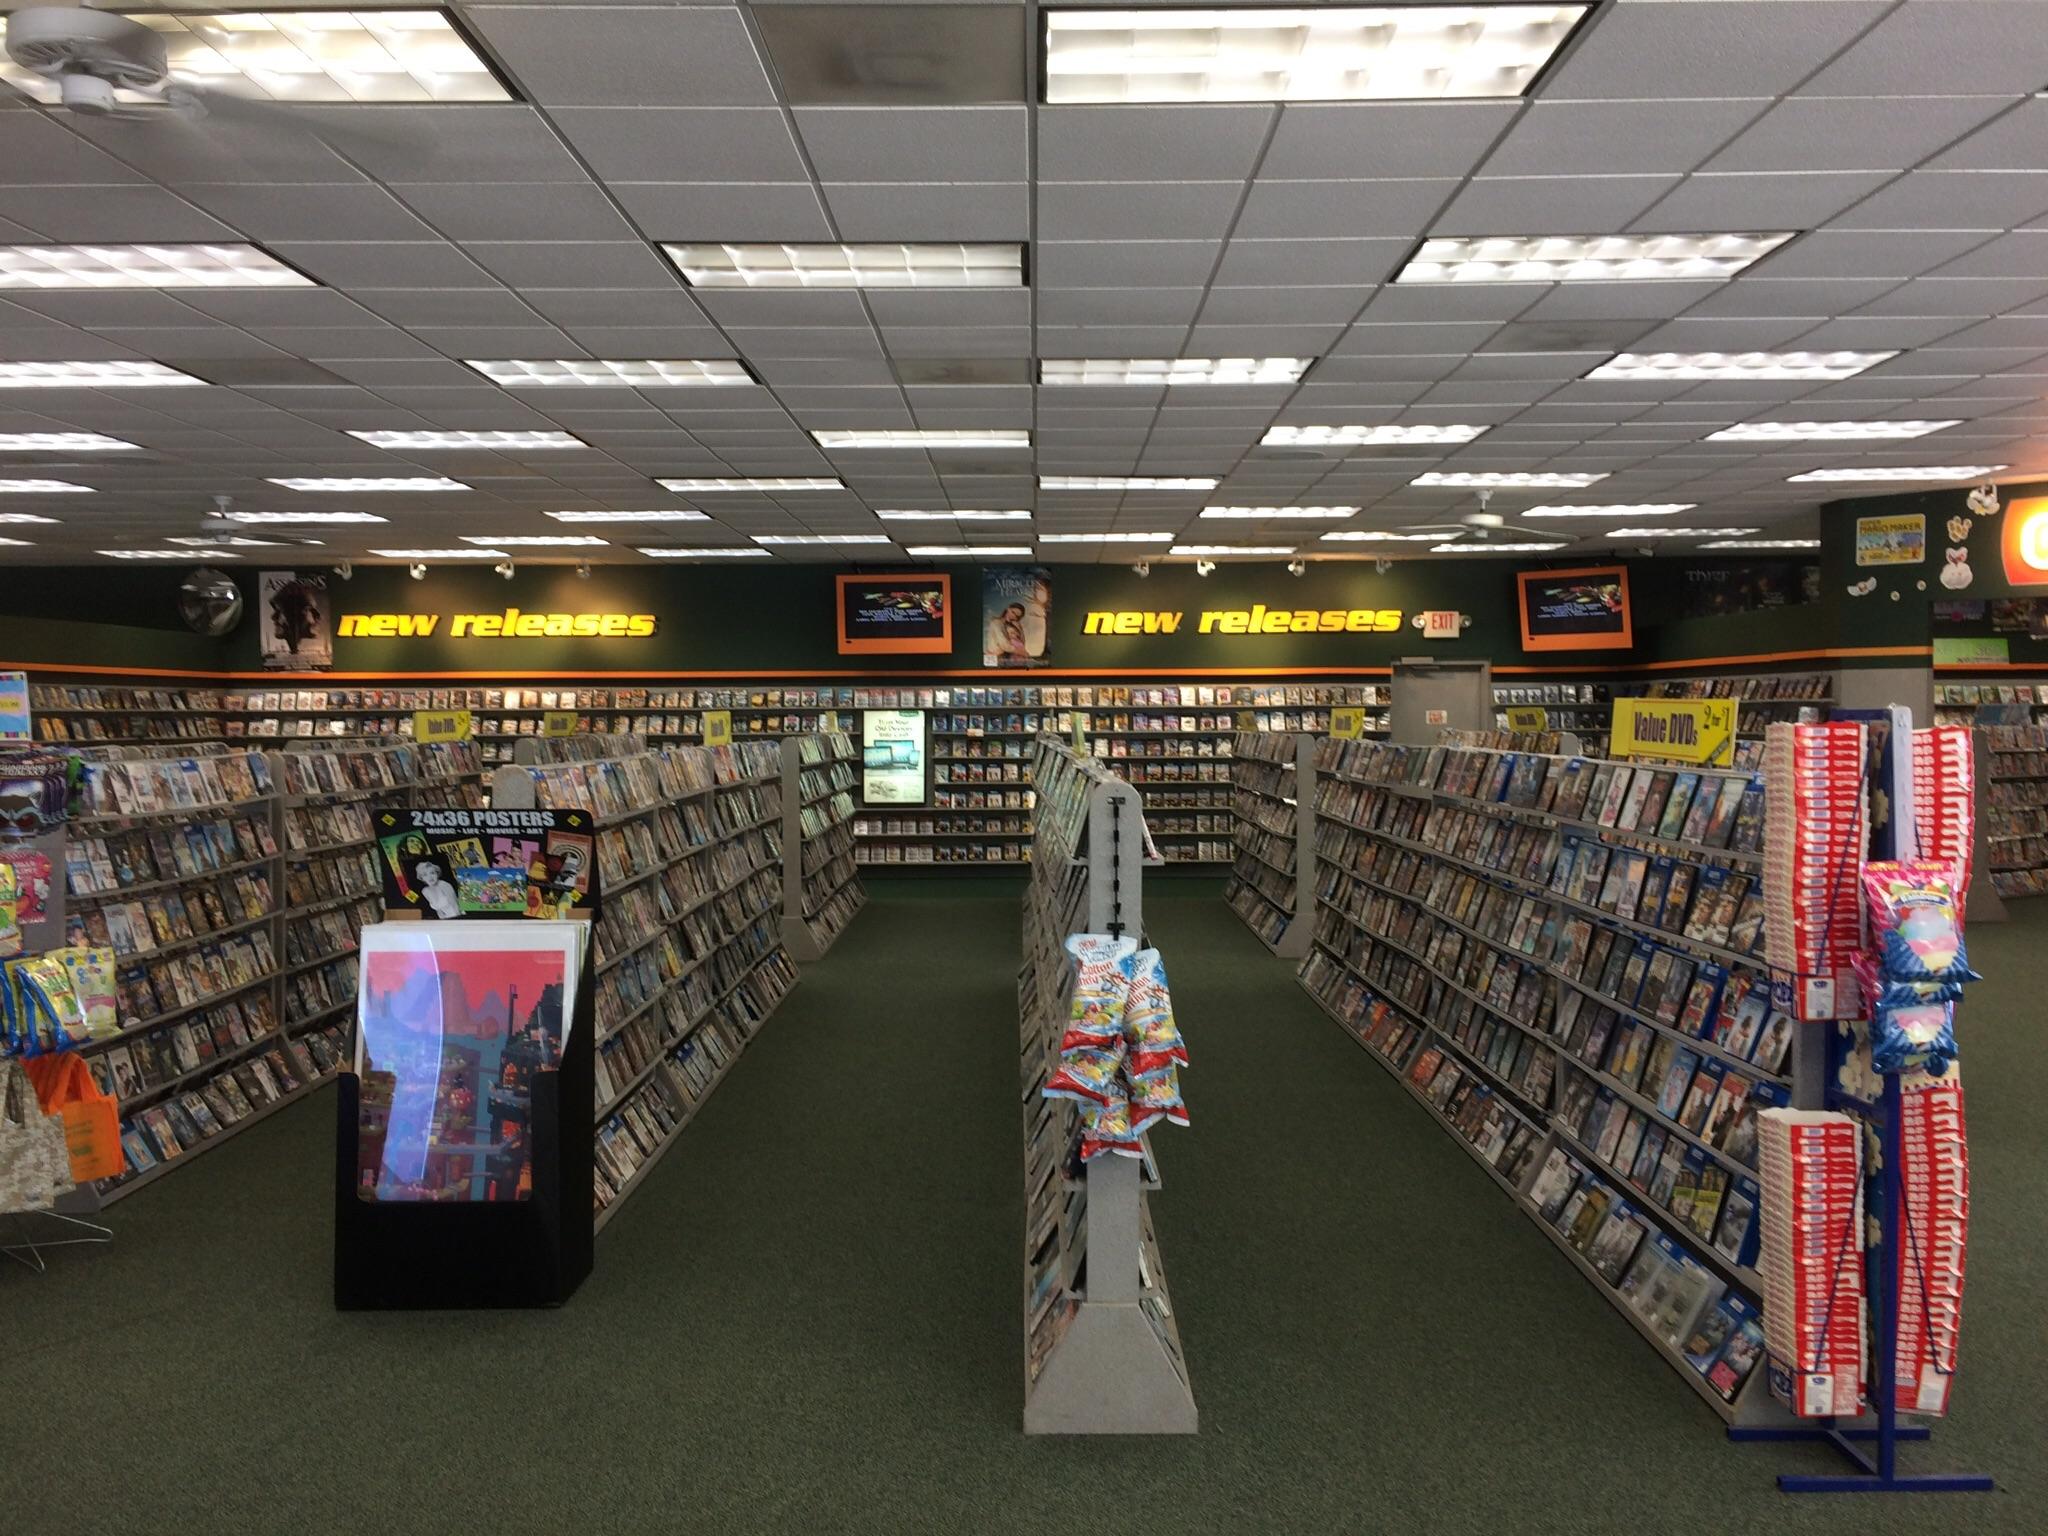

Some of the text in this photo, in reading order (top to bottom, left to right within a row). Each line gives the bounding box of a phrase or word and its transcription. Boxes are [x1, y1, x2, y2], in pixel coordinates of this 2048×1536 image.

[337, 607, 656, 637] new releases
[1082, 604, 1402, 635] new releases
[1431, 613, 1454, 630] EXIT
[1634, 711, 1698, 746] Value DVDs
[410, 810, 555, 827] 24x36 POSTERS
[426, 827, 543, 835] MUSIC LIFE MOVIES ART
[1081, 960, 1114, 976] Cotton
